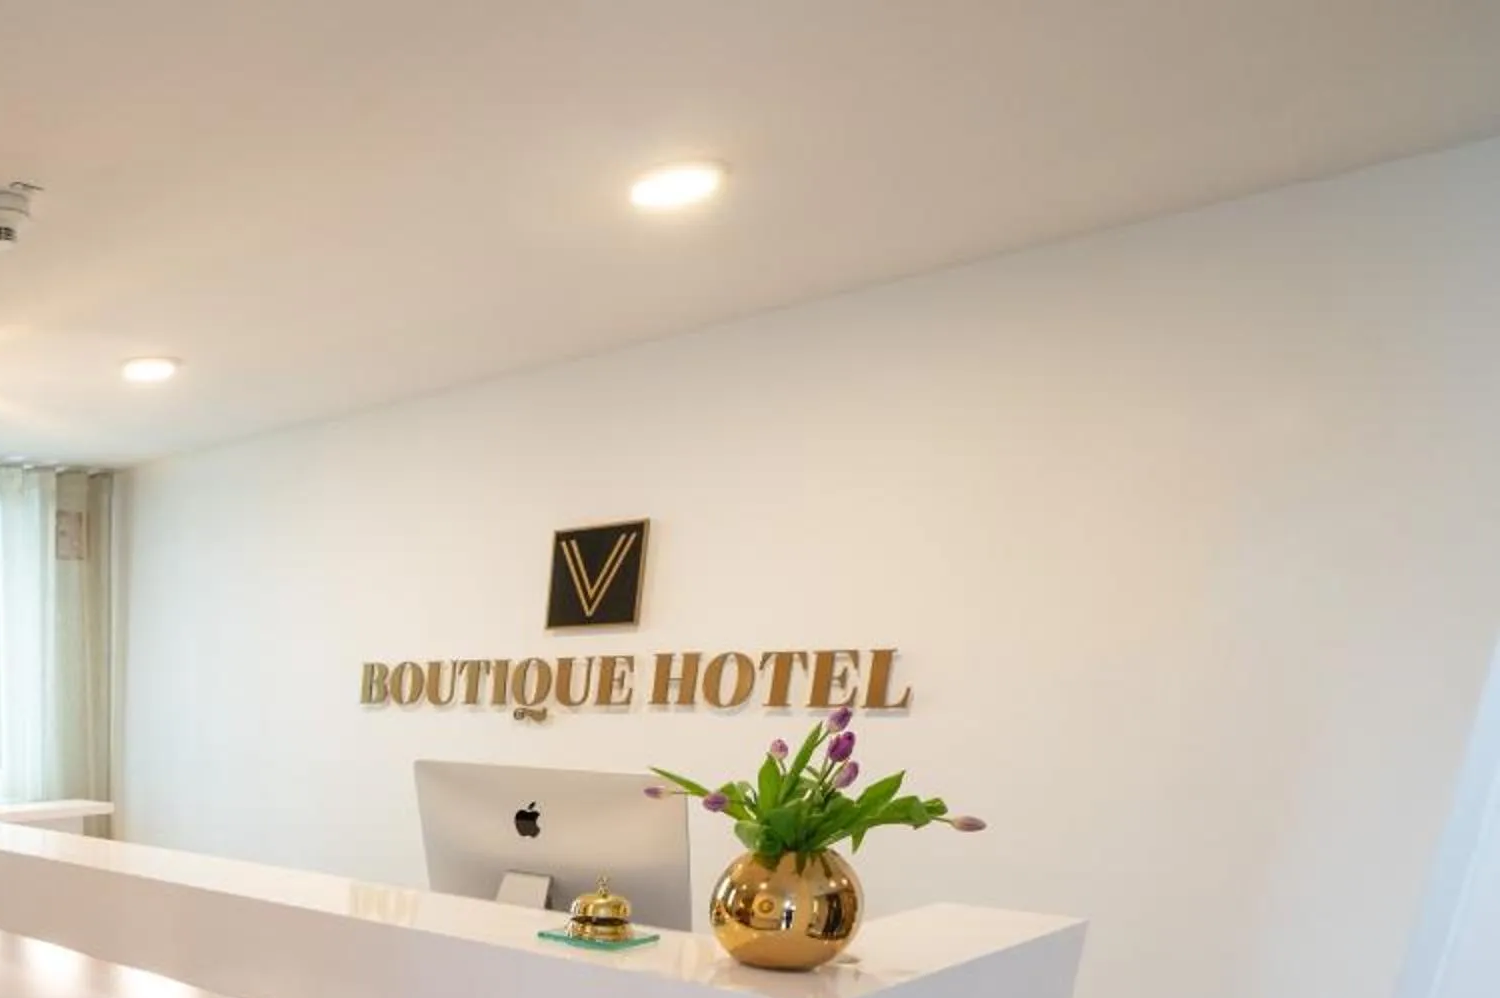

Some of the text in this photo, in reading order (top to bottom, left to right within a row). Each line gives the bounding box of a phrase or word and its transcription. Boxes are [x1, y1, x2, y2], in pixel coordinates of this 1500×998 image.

[560, 532, 637, 617] V
[360, 648, 913, 724] BOUTIQUE HOTEL
